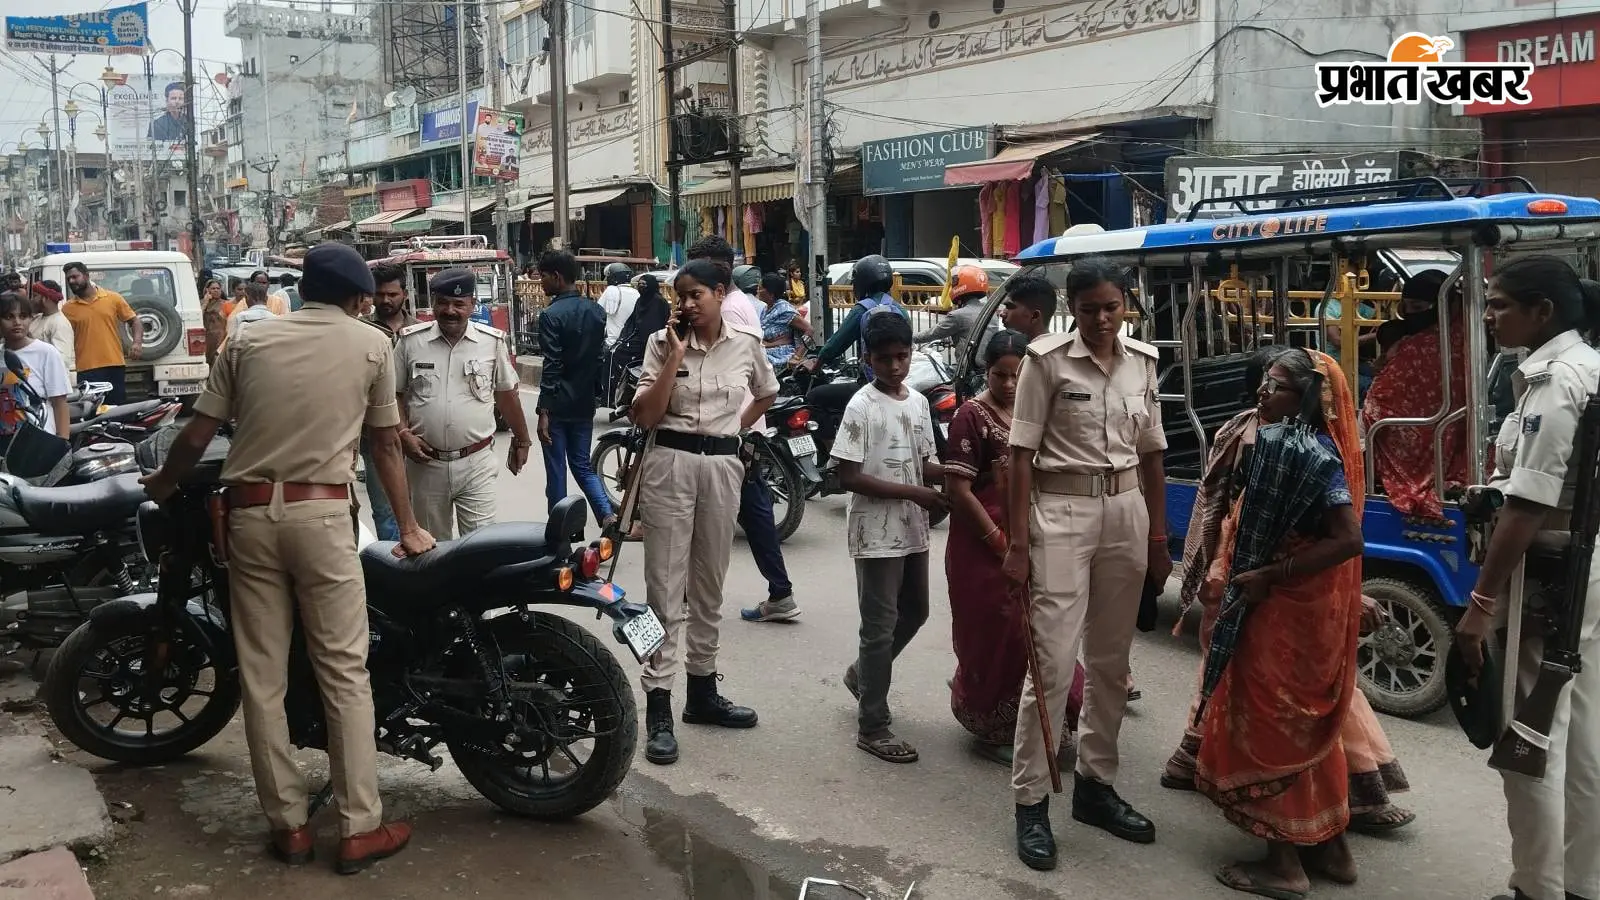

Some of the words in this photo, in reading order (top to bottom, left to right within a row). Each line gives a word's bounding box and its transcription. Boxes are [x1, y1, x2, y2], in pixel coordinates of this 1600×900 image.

[1497, 30, 1595, 67] DREAM
[867, 136, 934, 162] FASHION
[939, 130, 985, 154] CLUB
[924, 157, 945, 167] WEAR
[1212, 221, 1255, 241] CITY
[1284, 214, 1329, 234] LIFE
[168, 366, 205, 377] POLICE
